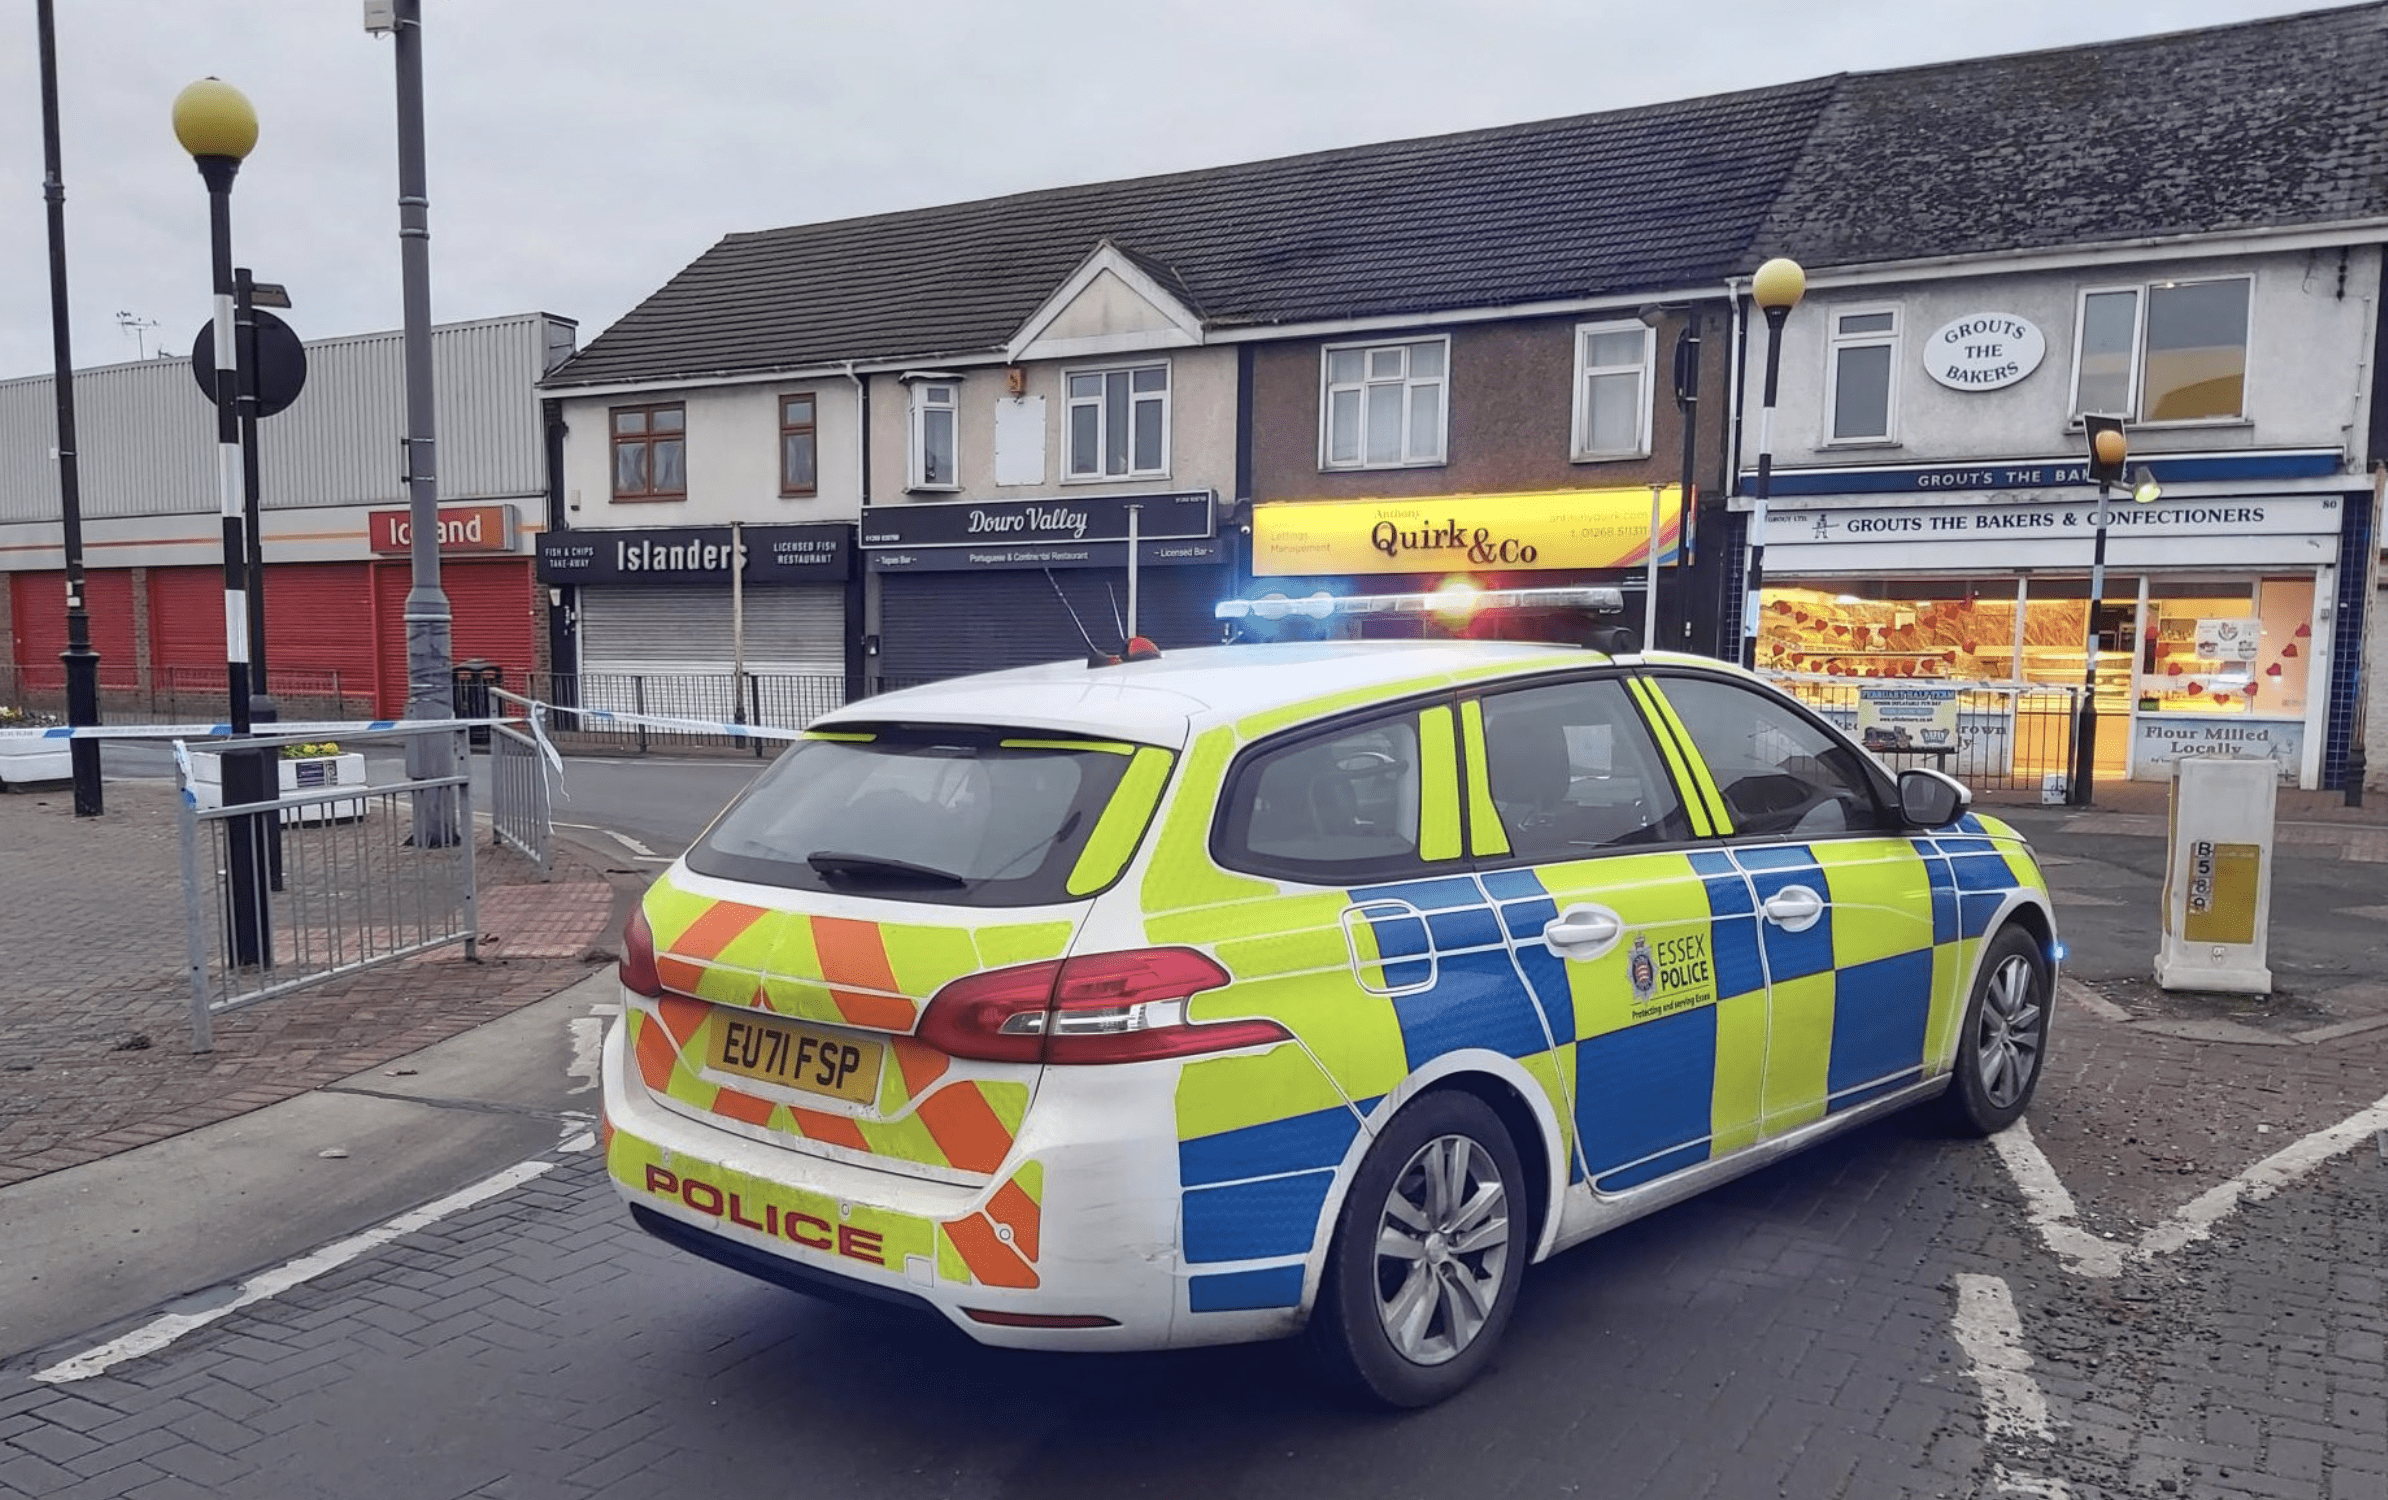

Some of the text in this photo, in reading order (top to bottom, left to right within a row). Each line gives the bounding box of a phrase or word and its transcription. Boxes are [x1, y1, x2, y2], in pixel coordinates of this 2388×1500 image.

[1944, 319, 2026, 343] GROUTS
[1964, 344, 2003, 359] THE
[1945, 361, 2019, 383] BAKERS
[1918, 470, 1993, 487] GROUT'S
[2006, 470, 2041, 483] THE
[2322, 500, 2338, 509] 80
[1374, 508, 1421, 520] Anthony
[1847, 507, 2265, 533] GROUTS THE BAKERS & CONFECTIONERS
[390, 514, 482, 545] Icand
[968, 507, 1087, 539] Douro Valley
[544, 546, 594, 557] FISH & CHIPS
[773, 541, 837, 552] LICENSED FISH
[1194, 546, 1207, 556] Bar
[549, 559, 589, 569] TAKE-AWAY
[777, 553, 832, 565] RESTAURANT
[1051, 551, 1089, 561] Restaurant
[1862, 690, 1955, 699] FEBRUARY HALF TERM
[2145, 726, 2269, 742] Flour Milled
[2170, 742, 2243, 754] Locally
[1657, 934, 1705, 967] ESSEX
[1660, 960, 1709, 991] POLICE
[1632, 993, 1711, 1020] Protecting and serving Essex
[722, 1021, 860, 1089] EU71 FSP
[645, 1163, 885, 1266] POLICE
